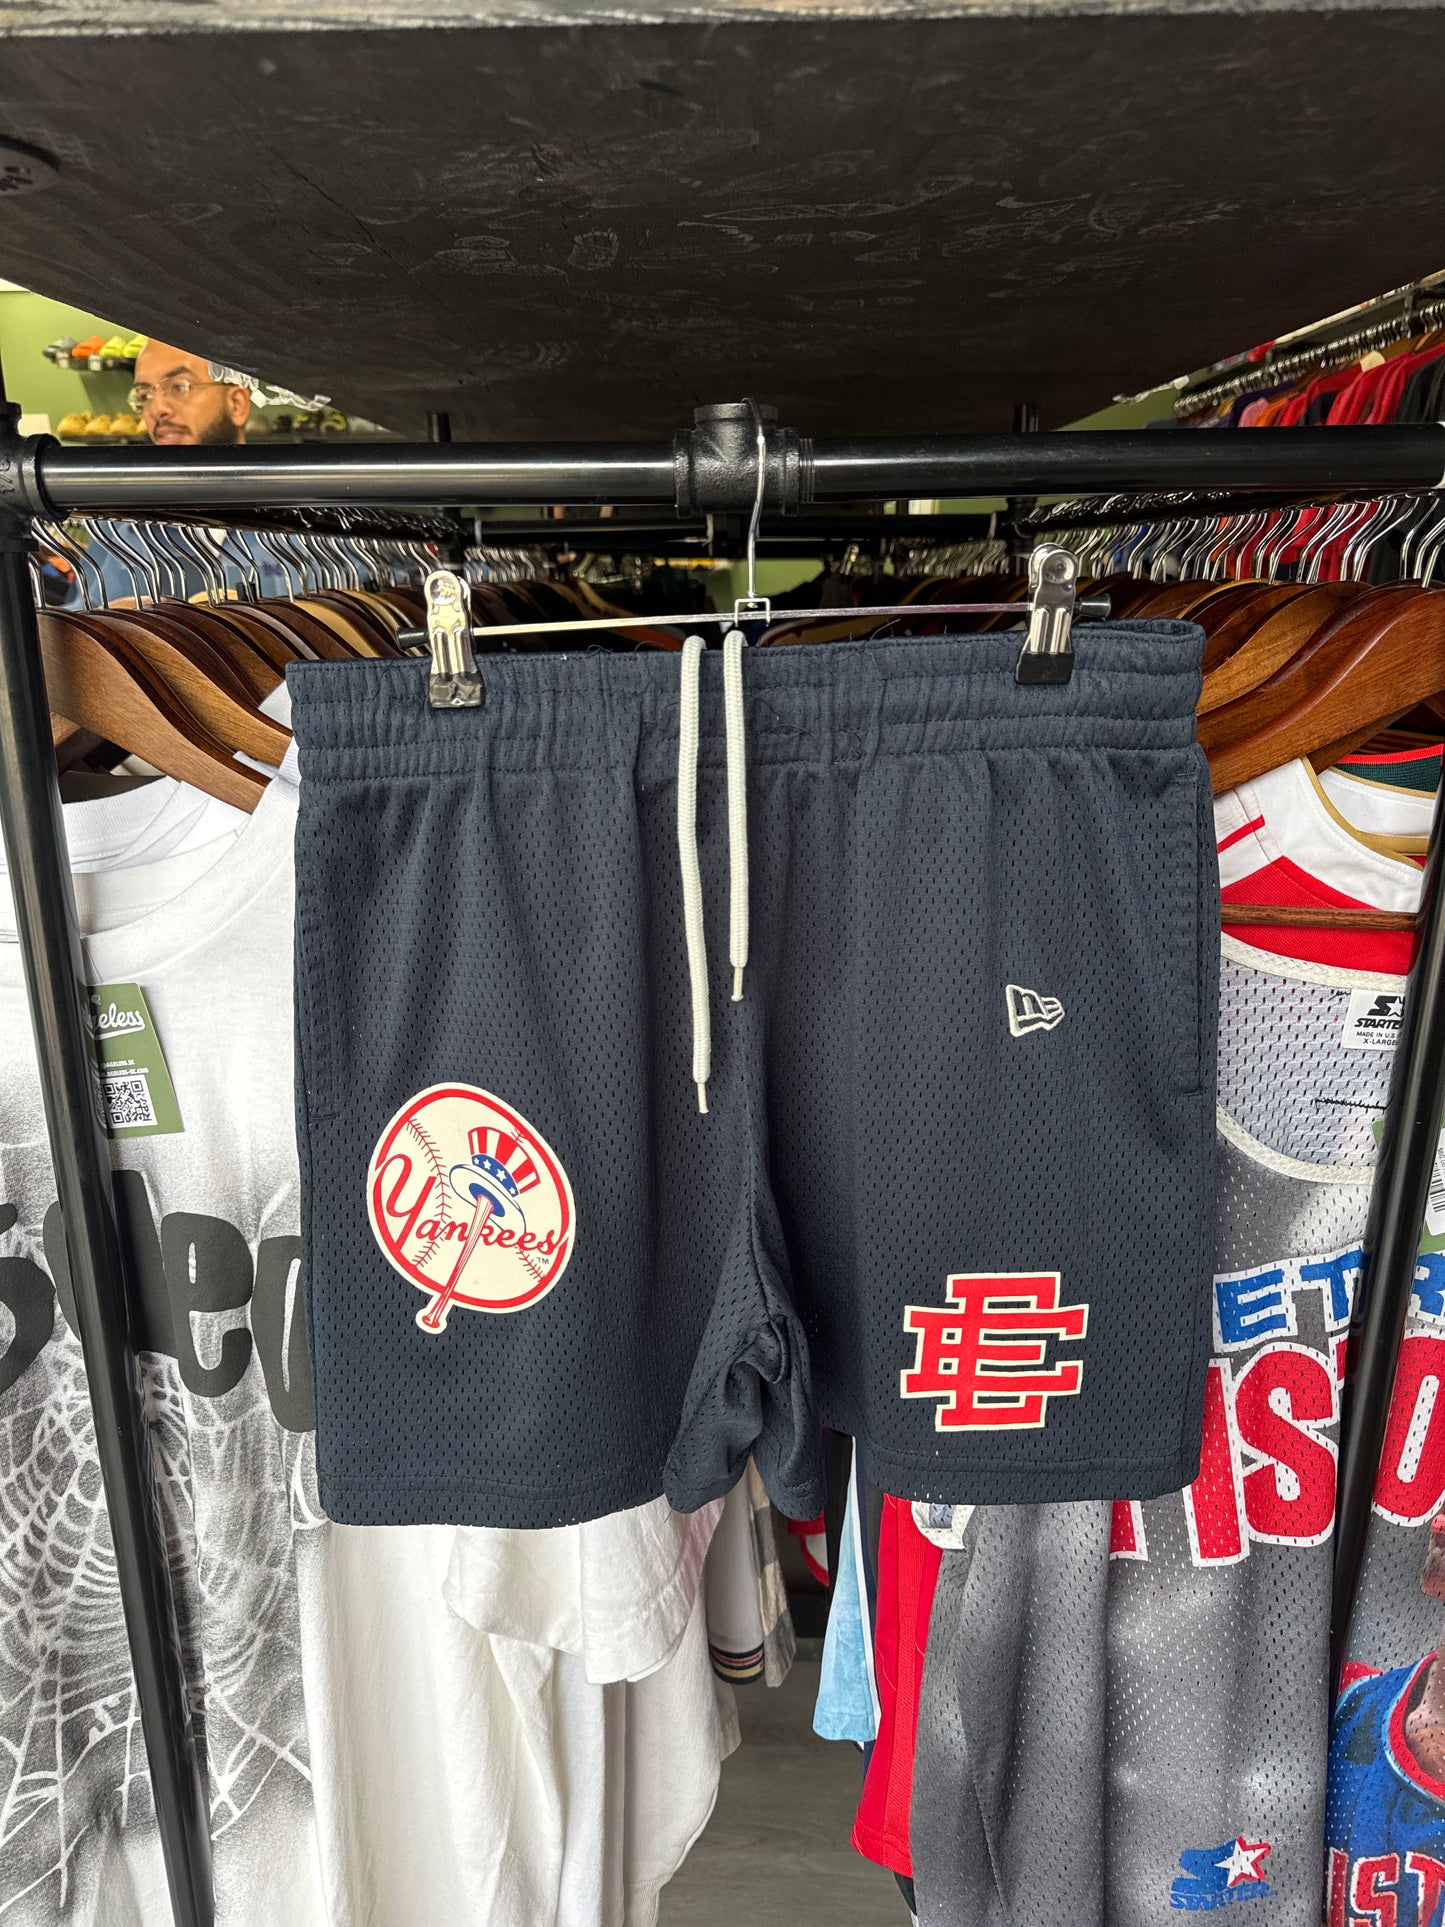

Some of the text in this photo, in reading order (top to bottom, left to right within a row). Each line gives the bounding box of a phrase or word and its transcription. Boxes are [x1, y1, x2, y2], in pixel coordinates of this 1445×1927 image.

[98, 1002, 145, 1031] eless
[1363, 1038, 1399, 1047] X-LARGE
[373, 1153, 564, 1256] Yankees
